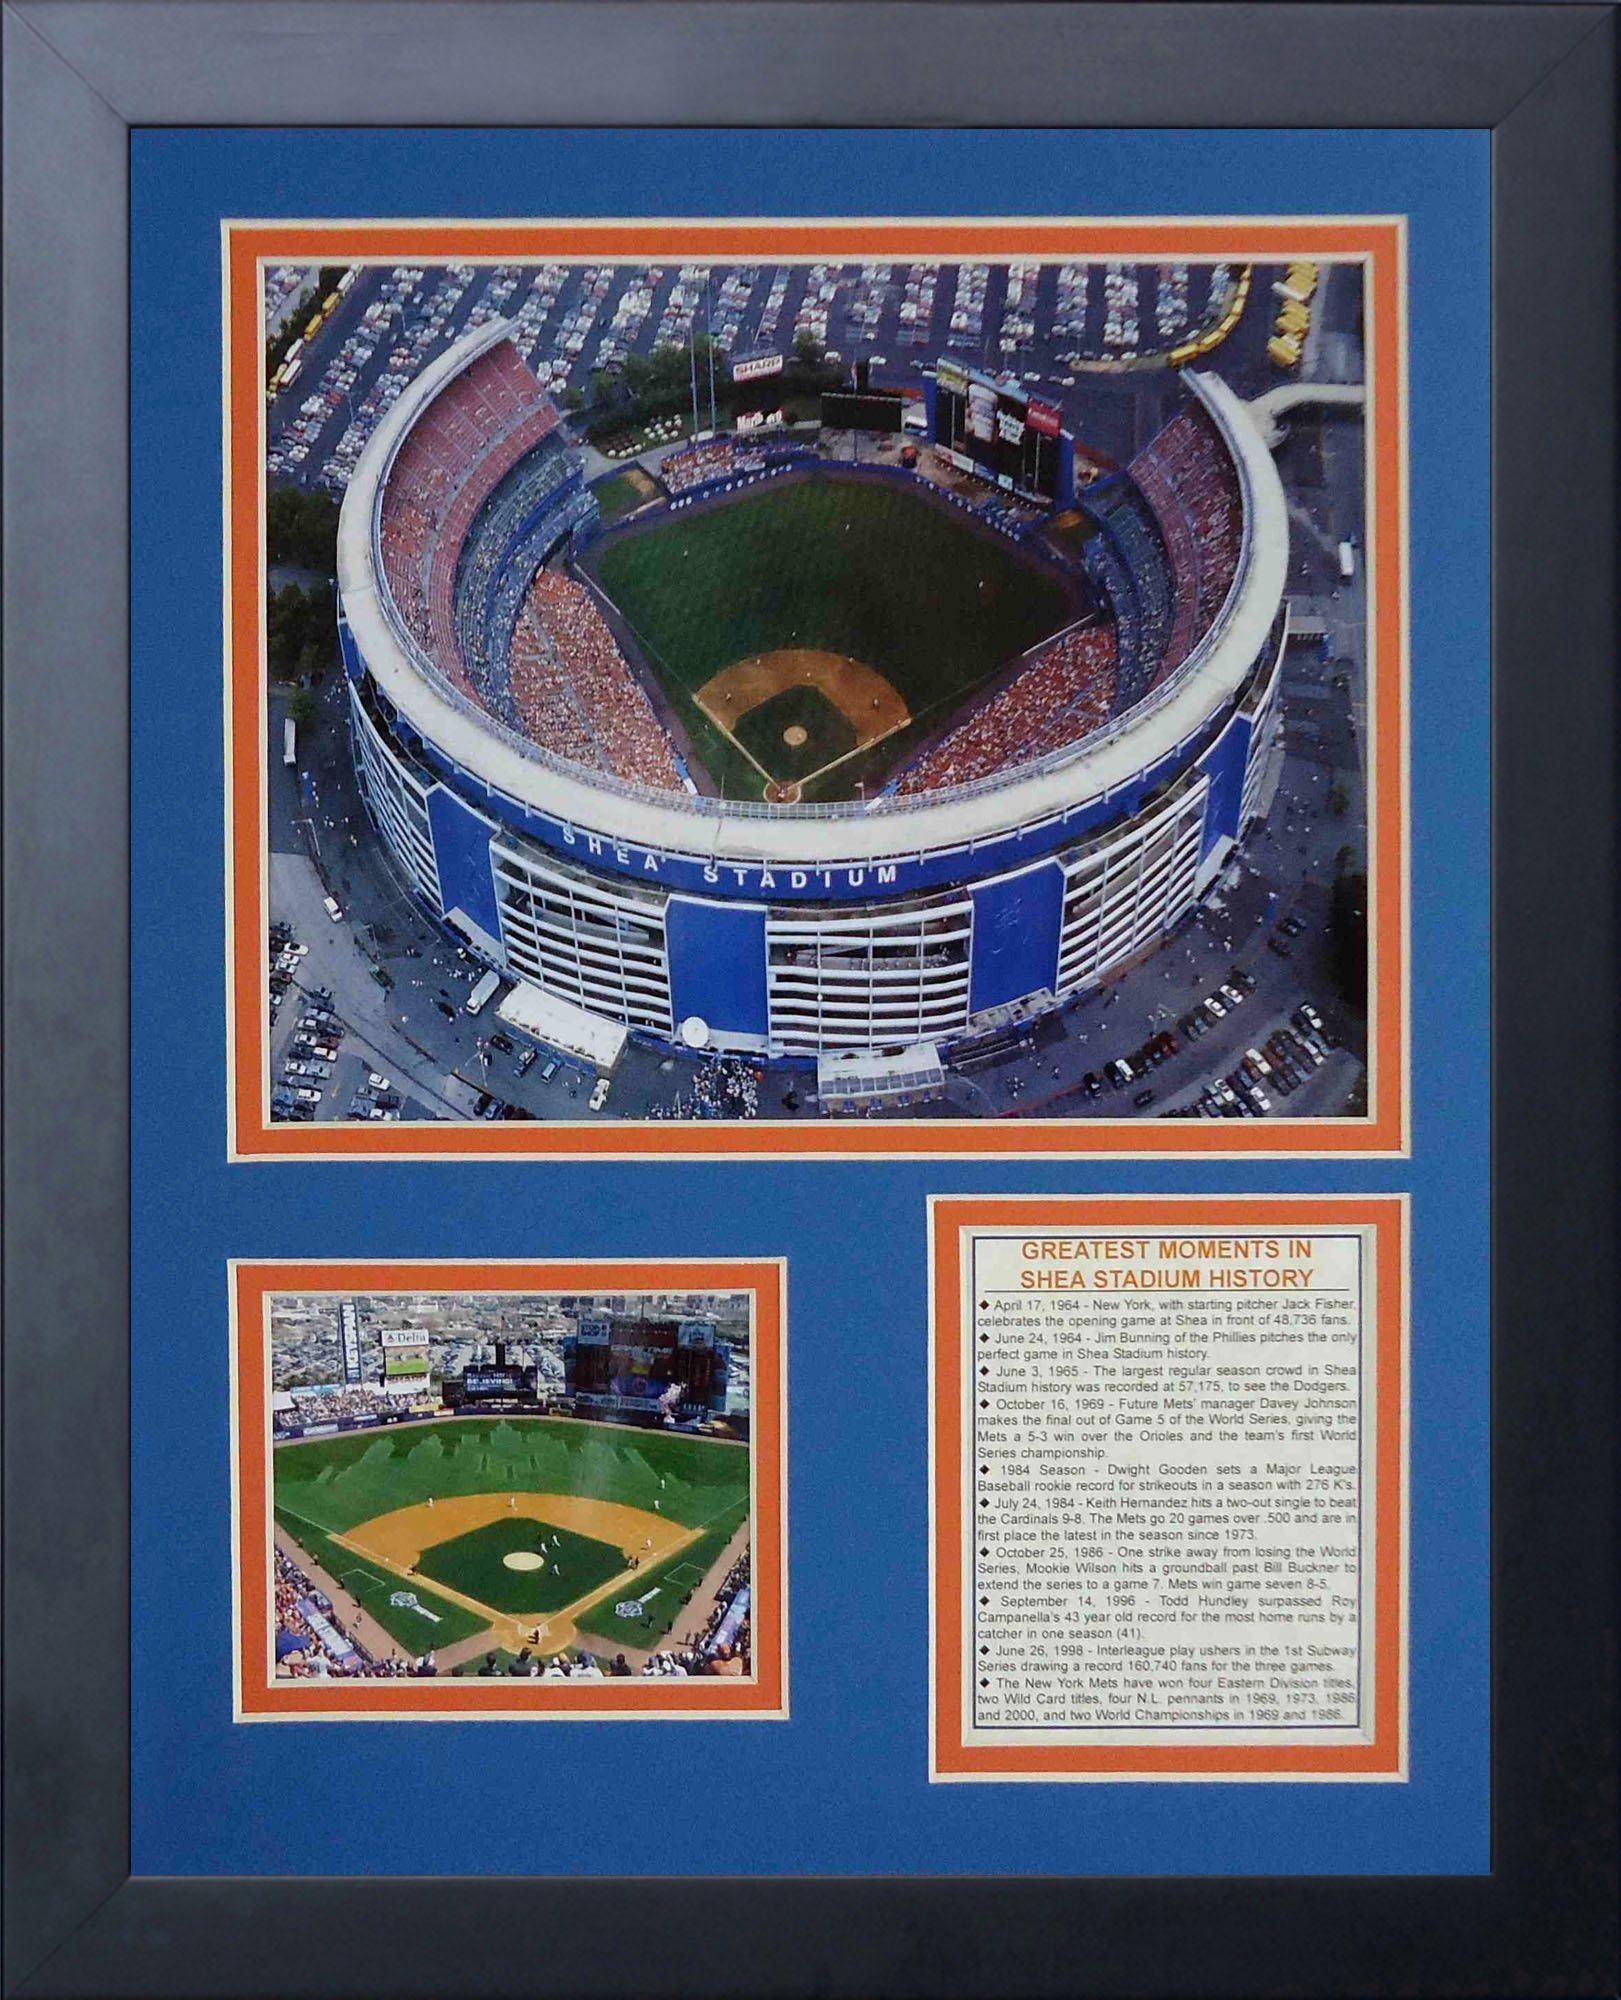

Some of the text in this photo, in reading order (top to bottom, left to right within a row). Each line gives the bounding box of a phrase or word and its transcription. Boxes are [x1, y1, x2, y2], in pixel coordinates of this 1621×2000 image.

[735, 357, 780, 373] SHARP
[563, 827, 897, 889] SHEA STADIUM
[1022, 1240, 1312, 1259] GREATEST MOMENTS IN
[1021, 1269, 1313, 1288] SHEA STADIUM HISTORY
[994, 1299, 1022, 1312] April
[1051, 1299, 1079, 1309] 1964
[1159, 1299, 1183, 1309] with
[1188, 1299, 1232, 1312] starting
[1237, 1299, 1278, 1312] pitcher
[1282, 1299, 1310, 1309] Jack
[978, 1315, 1041, 1325] celebrates
[1069, 1315, 1117, 1328] opening
[1121, 1317, 1155, 1328] game
[1227, 1315, 1254, 1325] front
[398, 1333, 427, 1343] Delta
[995, 1332, 1357, 1345] June 1964 Bunning Phillies pitches only
[978, 1348, 1210, 1361] perfect Shea Stadium history.
[996, 1365, 1357, 1378] June 1965 largest regular season crowd Shea
[978, 1381, 1027, 1391] Stadium
[1032, 1381, 1071, 1394] history
[1105, 1381, 1158, 1391] recorded
[1294, 1381, 1349, 1394] Dodgers.
[996, 1398, 1045, 1408] October
[1119, 1398, 1158, 1408] Future
[1201, 1400, 1255, 1411] manager
[1260, 1398, 1298, 1411] Davey
[1304, 1398, 1357, 1408] Johnson
[978, 1414, 1332, 1427] makes final Game World Series, giving
[978, 1430, 1357, 1440] Mets over Orioles team's first World
[978, 1447, 1108, 1460] Series championship.
[1040, 1463, 1357, 1477] Season Dwight Gooden sets Major League
[978, 1480, 1301, 1490] Baseball rookie record strikeouts season with
[995, 1497, 1357, 1510] July 1984 Keith Hernandez two-out single beat
[1001, 1513, 1260, 1526] Cardinals Mets games over
[978, 1529, 1219, 1542] first place latest season since
[996, 1546, 1356, 1559] October strike away from losing World
[978, 1562, 1339, 1575] Series, Mookie Wilson hits groundball Bill Buckner
[978, 1578, 1301, 1591] extend series game Mets game seven
[1001, 1595, 1321, 1608] September Todd Hundley surpassed
[978, 1611, 1325, 1624] Campanella's year record most runs
[978, 1628, 1112, 1638] catcher season
[996, 1645, 1355, 1658] June 1998 Interleague play ushers Subway
[978, 1661, 1016, 1671] Series
[1021, 1661, 1068, 1674] drawing
[1085, 1661, 1122, 1671] record
[1255, 1661, 1285, 1671] three
[1291, 1663, 1335, 1674] games.
[1057, 1678, 1083, 1688] York
[1089, 1678, 1118, 1688] Mets
[1124, 1678, 1153, 1688] have
[1218, 1678, 1264, 1688] Eastern
[1270, 1678, 1317, 1688] Division
[1004, 1693, 1224, 1706] Wild Card titles, four pennants
[1095, 1709, 1229, 1723] World Championships
